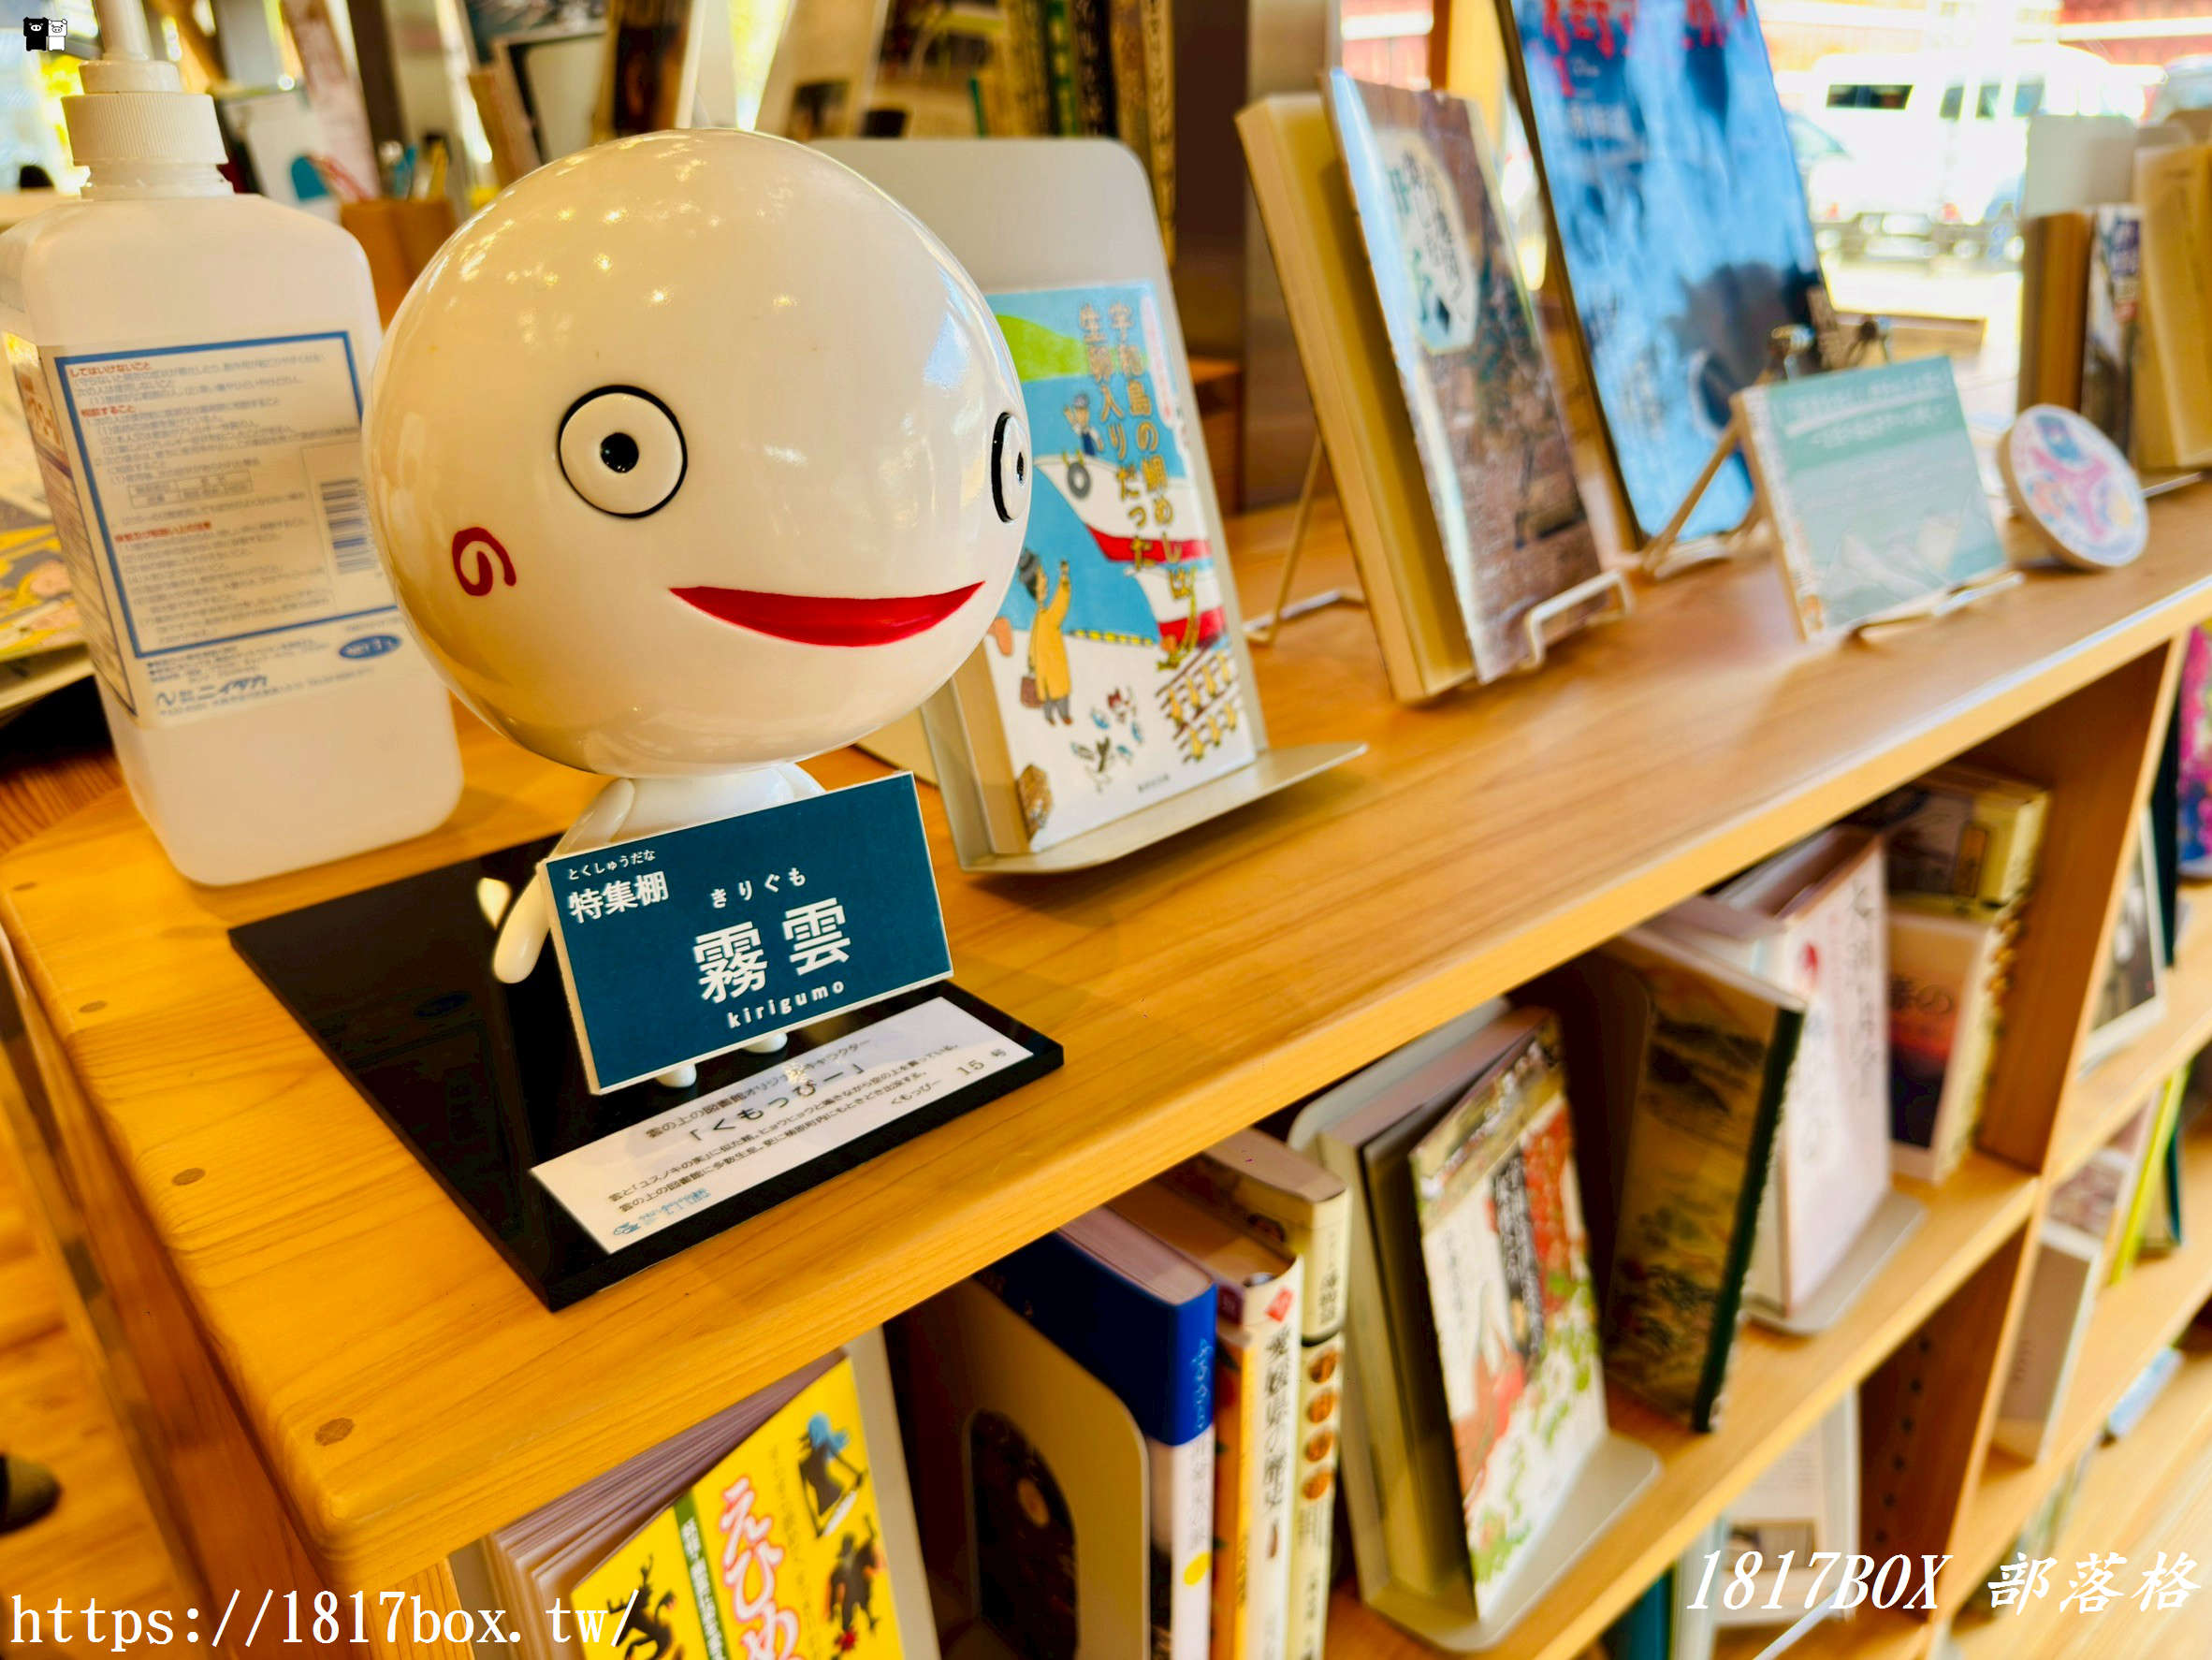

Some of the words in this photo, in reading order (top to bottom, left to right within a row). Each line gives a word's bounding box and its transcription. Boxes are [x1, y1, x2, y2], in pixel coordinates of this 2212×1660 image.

[567, 850, 656, 881] とくしゅうだな
[710, 866, 808, 909] きりぐも
[567, 870, 670, 924] 特集棚
[692, 896, 851, 1004] 霧雲
[727, 979, 846, 1029] kirigumo
[644, 1037, 872, 1139] 雲の上の図書館オリジナキャラクター
[887, 1078, 945, 1106] くもっぴー
[954, 1058, 986, 1076] 15
